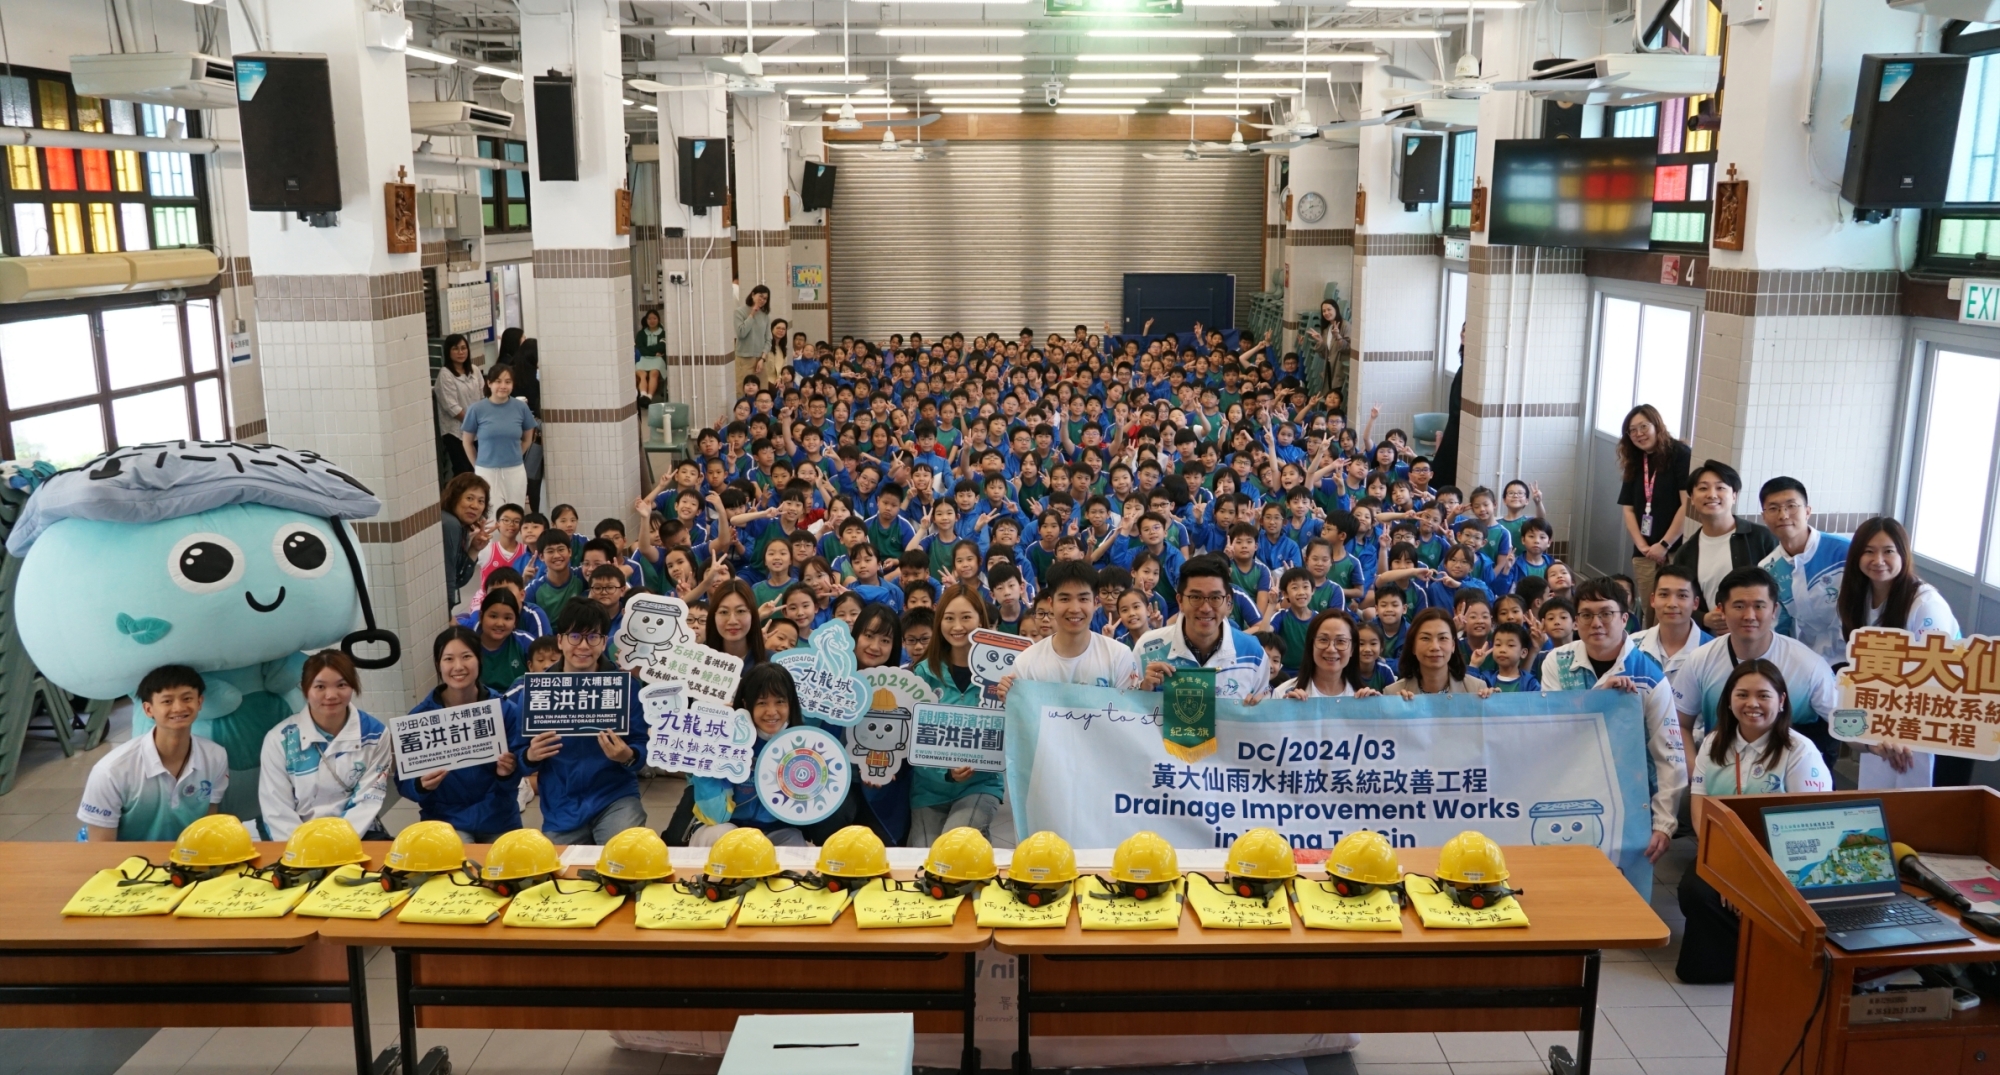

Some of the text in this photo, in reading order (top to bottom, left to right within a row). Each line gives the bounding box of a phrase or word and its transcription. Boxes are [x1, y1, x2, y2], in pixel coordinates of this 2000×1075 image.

[1686, 258, 1695, 286] 4
[1845, 630, 2000, 694] 黃大仙
[530, 676, 623, 687] 沙田公園 大埔舊墟
[801, 667, 853, 693] 九龍城
[529, 689, 623, 711] 蓄洪計劃
[396, 714, 441, 732] 沙田公園
[658, 711, 729, 739] 九龍城
[1048, 709, 1101, 730] way
[1102, 702, 1135, 722] to
[399, 717, 496, 754] 蓄洪計劃
[916, 723, 1005, 751] 蓄洪計劃
[1170, 726, 1209, 737] 紀念旗
[1870, 714, 1976, 748] 改善工程
[408, 746, 494, 766] STORMWATER STORAGE SCHEME
[652, 750, 713, 771] 改善工程
[654, 733, 748, 762] 雨水排放系統
[915, 754, 952, 762] STORMWATER
[1238, 735, 1396, 766] DC/2024/03
[1152, 763, 1488, 794] 黃大仙雨水排放系統改善工程
[1114, 793, 1520, 826] Drainage Improvement Works
[1215, 826, 1238, 848] in
